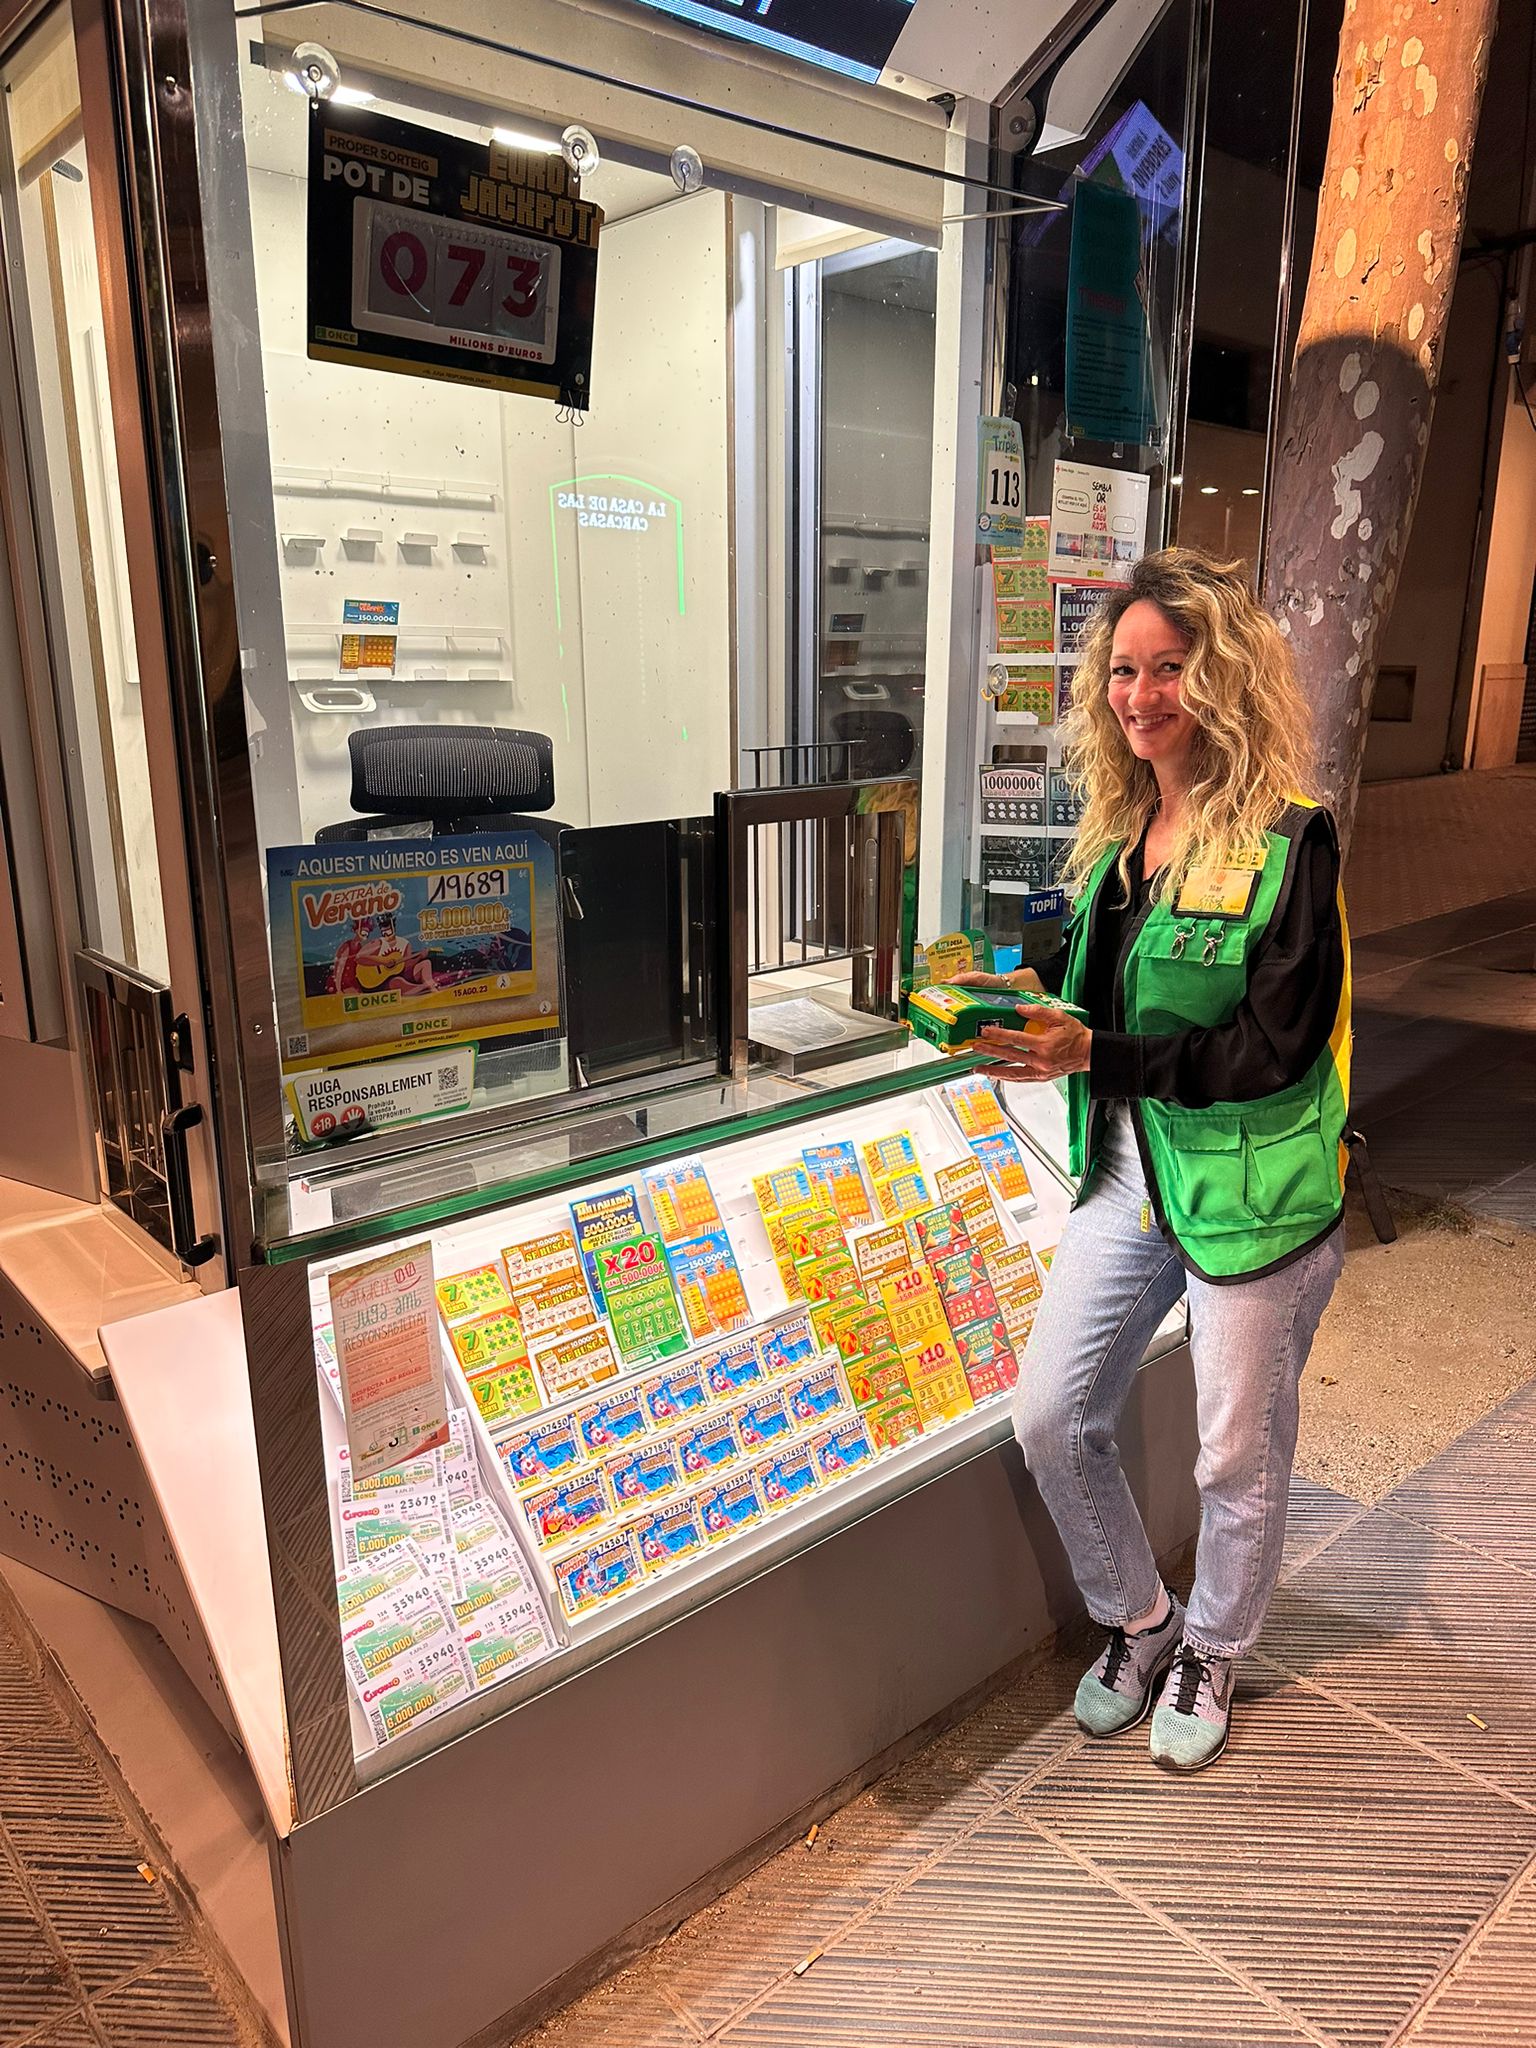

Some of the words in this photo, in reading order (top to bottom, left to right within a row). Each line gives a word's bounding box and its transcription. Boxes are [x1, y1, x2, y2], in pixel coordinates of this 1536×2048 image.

[329, 135, 378, 156] PROPER
[380, 147, 429, 171] SORTEIG
[323, 154, 388, 192] POT
[392, 171, 430, 205] DE
[460, 175, 593, 243] JACKPOT
[450, 335, 494, 353] MILIONS
[498, 344, 543, 361] D'EUROS
[990, 468, 1020, 508] 113
[1096, 492, 1107, 504] OR
[298, 855, 365, 877] AQUEST
[369, 849, 437, 871] NÚMERO
[440, 848, 459, 864] ES
[461, 846, 491, 862] VEN
[494, 842, 529, 861] AQUÍ
[333, 886, 376, 905] EXTRA
[378, 883, 390, 897] de
[303, 891, 400, 928] Verano
[360, 993, 397, 1008] ONCE
[415, 1018, 448, 1031] ONCE
[307, 1078, 341, 1098] JUGA
[308, 1071, 433, 1113] RESPONSABLEMENT
[367, 1099, 394, 1110] Prohibida
[375, 1106, 391, 1115] venda
[314, 1116, 332, 1132] +18
[368, 1107, 412, 1123] AUTOPROHIBITS
[583, 1211, 637, 1238] 500.000€
[525, 1251, 538, 1262] SE
[539, 1239, 570, 1258] BUSCA
[621, 1261, 665, 1285] 500.000€
[443, 1283, 457, 1302] 7
[538, 1300, 552, 1312] SE
[552, 1287, 583, 1307] BUSCA
[344, 1311, 428, 1353] RESPONSABILITAT
[462, 1330, 476, 1351] 7
[560, 1353, 573, 1364] SE
[573, 1339, 605, 1359] BUSCA
[727, 1340, 752, 1356] 51242
[670, 1364, 695, 1381] 24039
[810, 1367, 832, 1383] 74367
[477, 1382, 492, 1403] 7
[608, 1389, 634, 1406] 81591
[756, 1391, 779, 1407] 97376
[421, 1419, 440, 1431] ONCE
[541, 1417, 568, 1435] 07450
[702, 1415, 727, 1432] 24039
[497, 1436, 531, 1459] Verano
[642, 1441, 669, 1458] 67183
[781, 1445, 806, 1461] 07450
[569, 1472, 596, 1491] 51242
[725, 1473, 750, 1490] 81591
[359, 1492, 377, 1500] ONCE
[400, 1494, 437, 1511] 23679
[525, 1489, 558, 1514] Verano
[663, 1500, 690, 1518] 97376
[598, 1533, 626, 1551] 74367
[365, 1543, 402, 1567] 35940
[473, 1547, 509, 1571] 35940
[556, 1554, 589, 1580] Verano
[392, 1586, 430, 1613] 35940
[498, 1601, 533, 1626] 35940
[418, 1643, 455, 1672] 35940
[394, 1720, 414, 1735] ONCE
